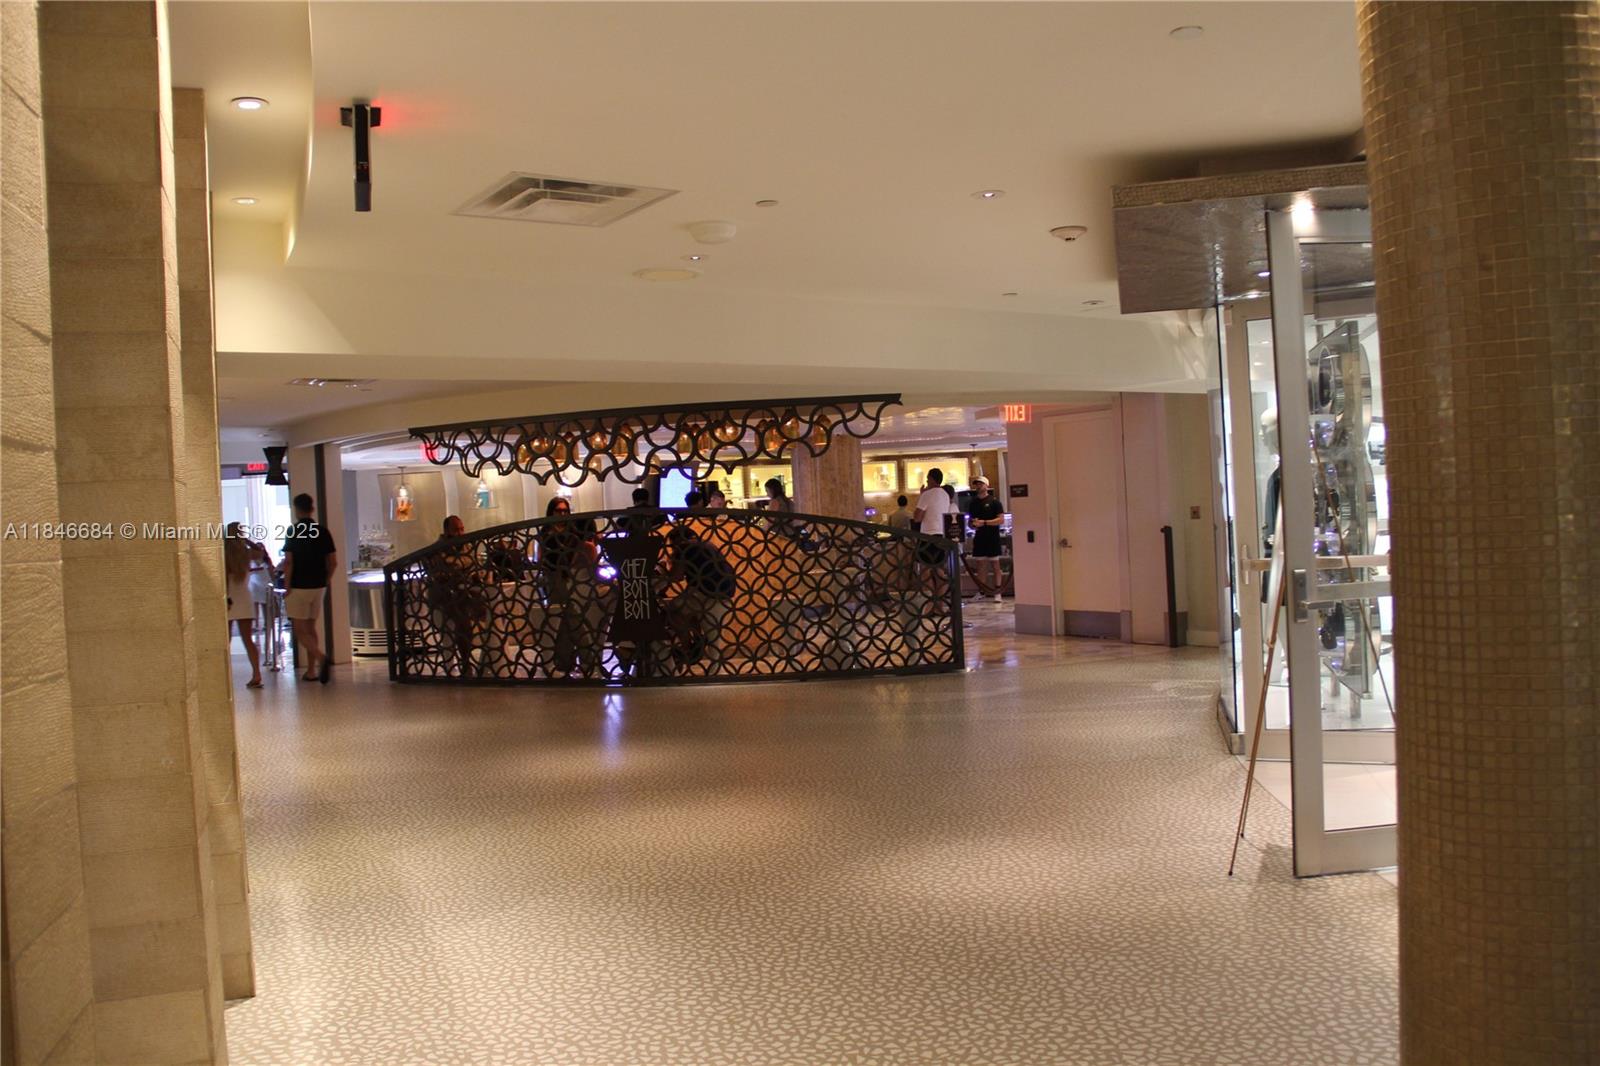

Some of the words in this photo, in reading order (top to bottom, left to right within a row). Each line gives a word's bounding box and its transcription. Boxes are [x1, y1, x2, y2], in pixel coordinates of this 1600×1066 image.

[620, 558, 647, 578] CHEZ
[623, 579, 649, 599] BON
[624, 600, 650, 619] BON
